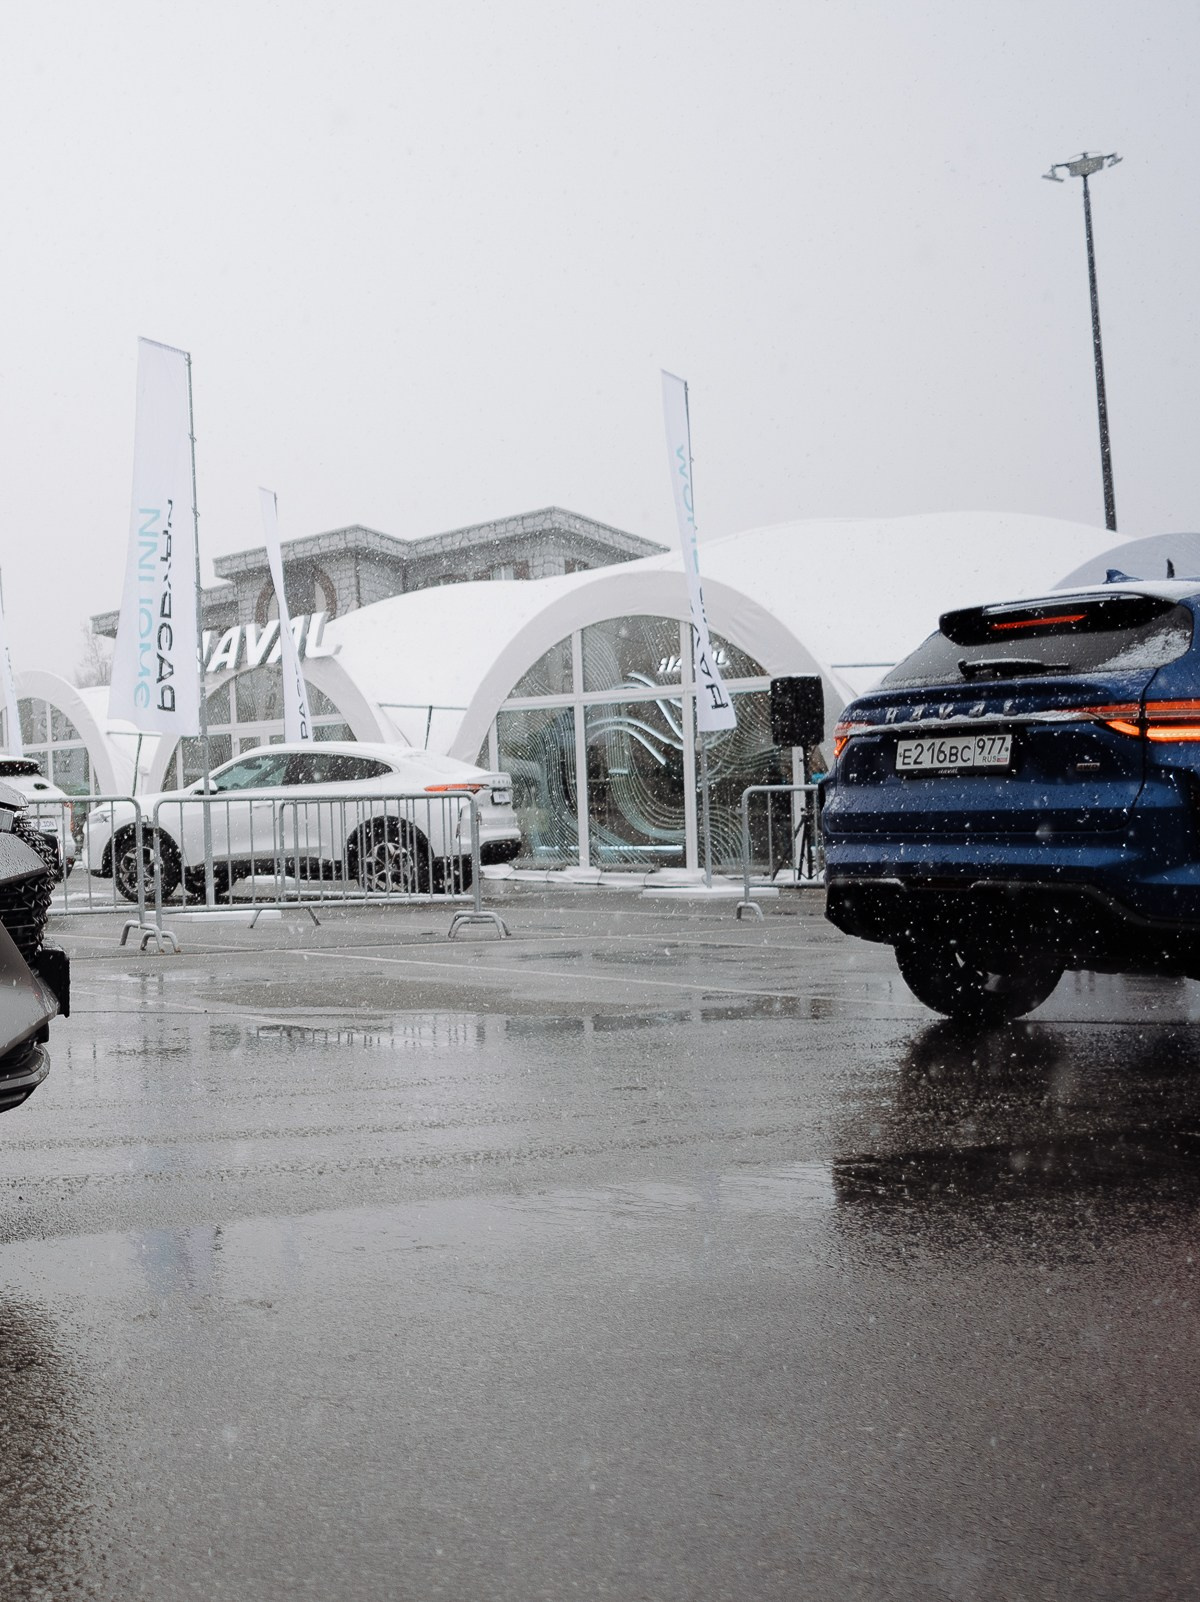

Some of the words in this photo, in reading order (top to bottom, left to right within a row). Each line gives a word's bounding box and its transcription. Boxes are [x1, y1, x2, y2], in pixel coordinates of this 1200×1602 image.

[885, 700, 1017, 724] HAVAL
[901, 743, 972, 767] Е216ВС
[976, 737, 1006, 755] 977
[982, 755, 997, 764] RUS
